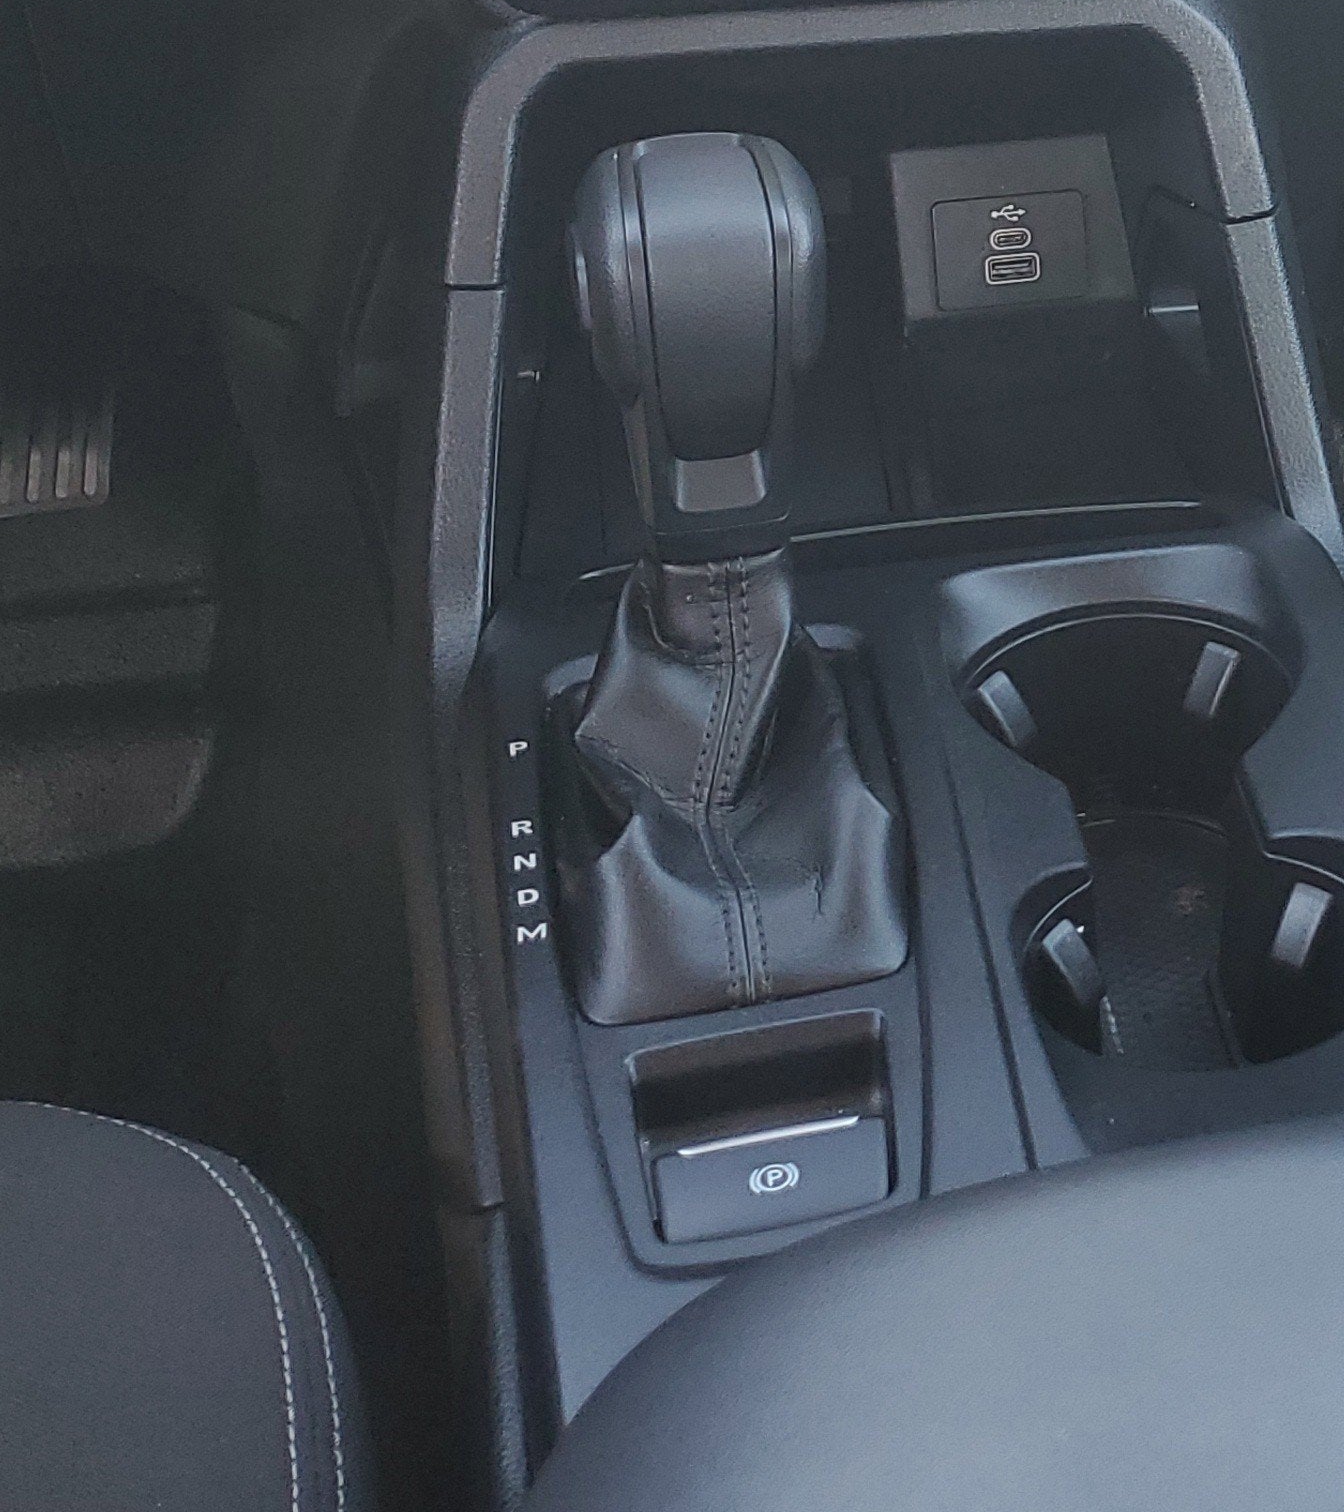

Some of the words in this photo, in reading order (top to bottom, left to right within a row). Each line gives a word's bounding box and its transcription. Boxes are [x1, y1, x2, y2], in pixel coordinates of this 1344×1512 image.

[509, 741, 528, 757] P
[511, 820, 533, 837] R
[514, 853, 537, 871] N
[517, 889, 540, 906] D
[517, 923, 547, 945] M
